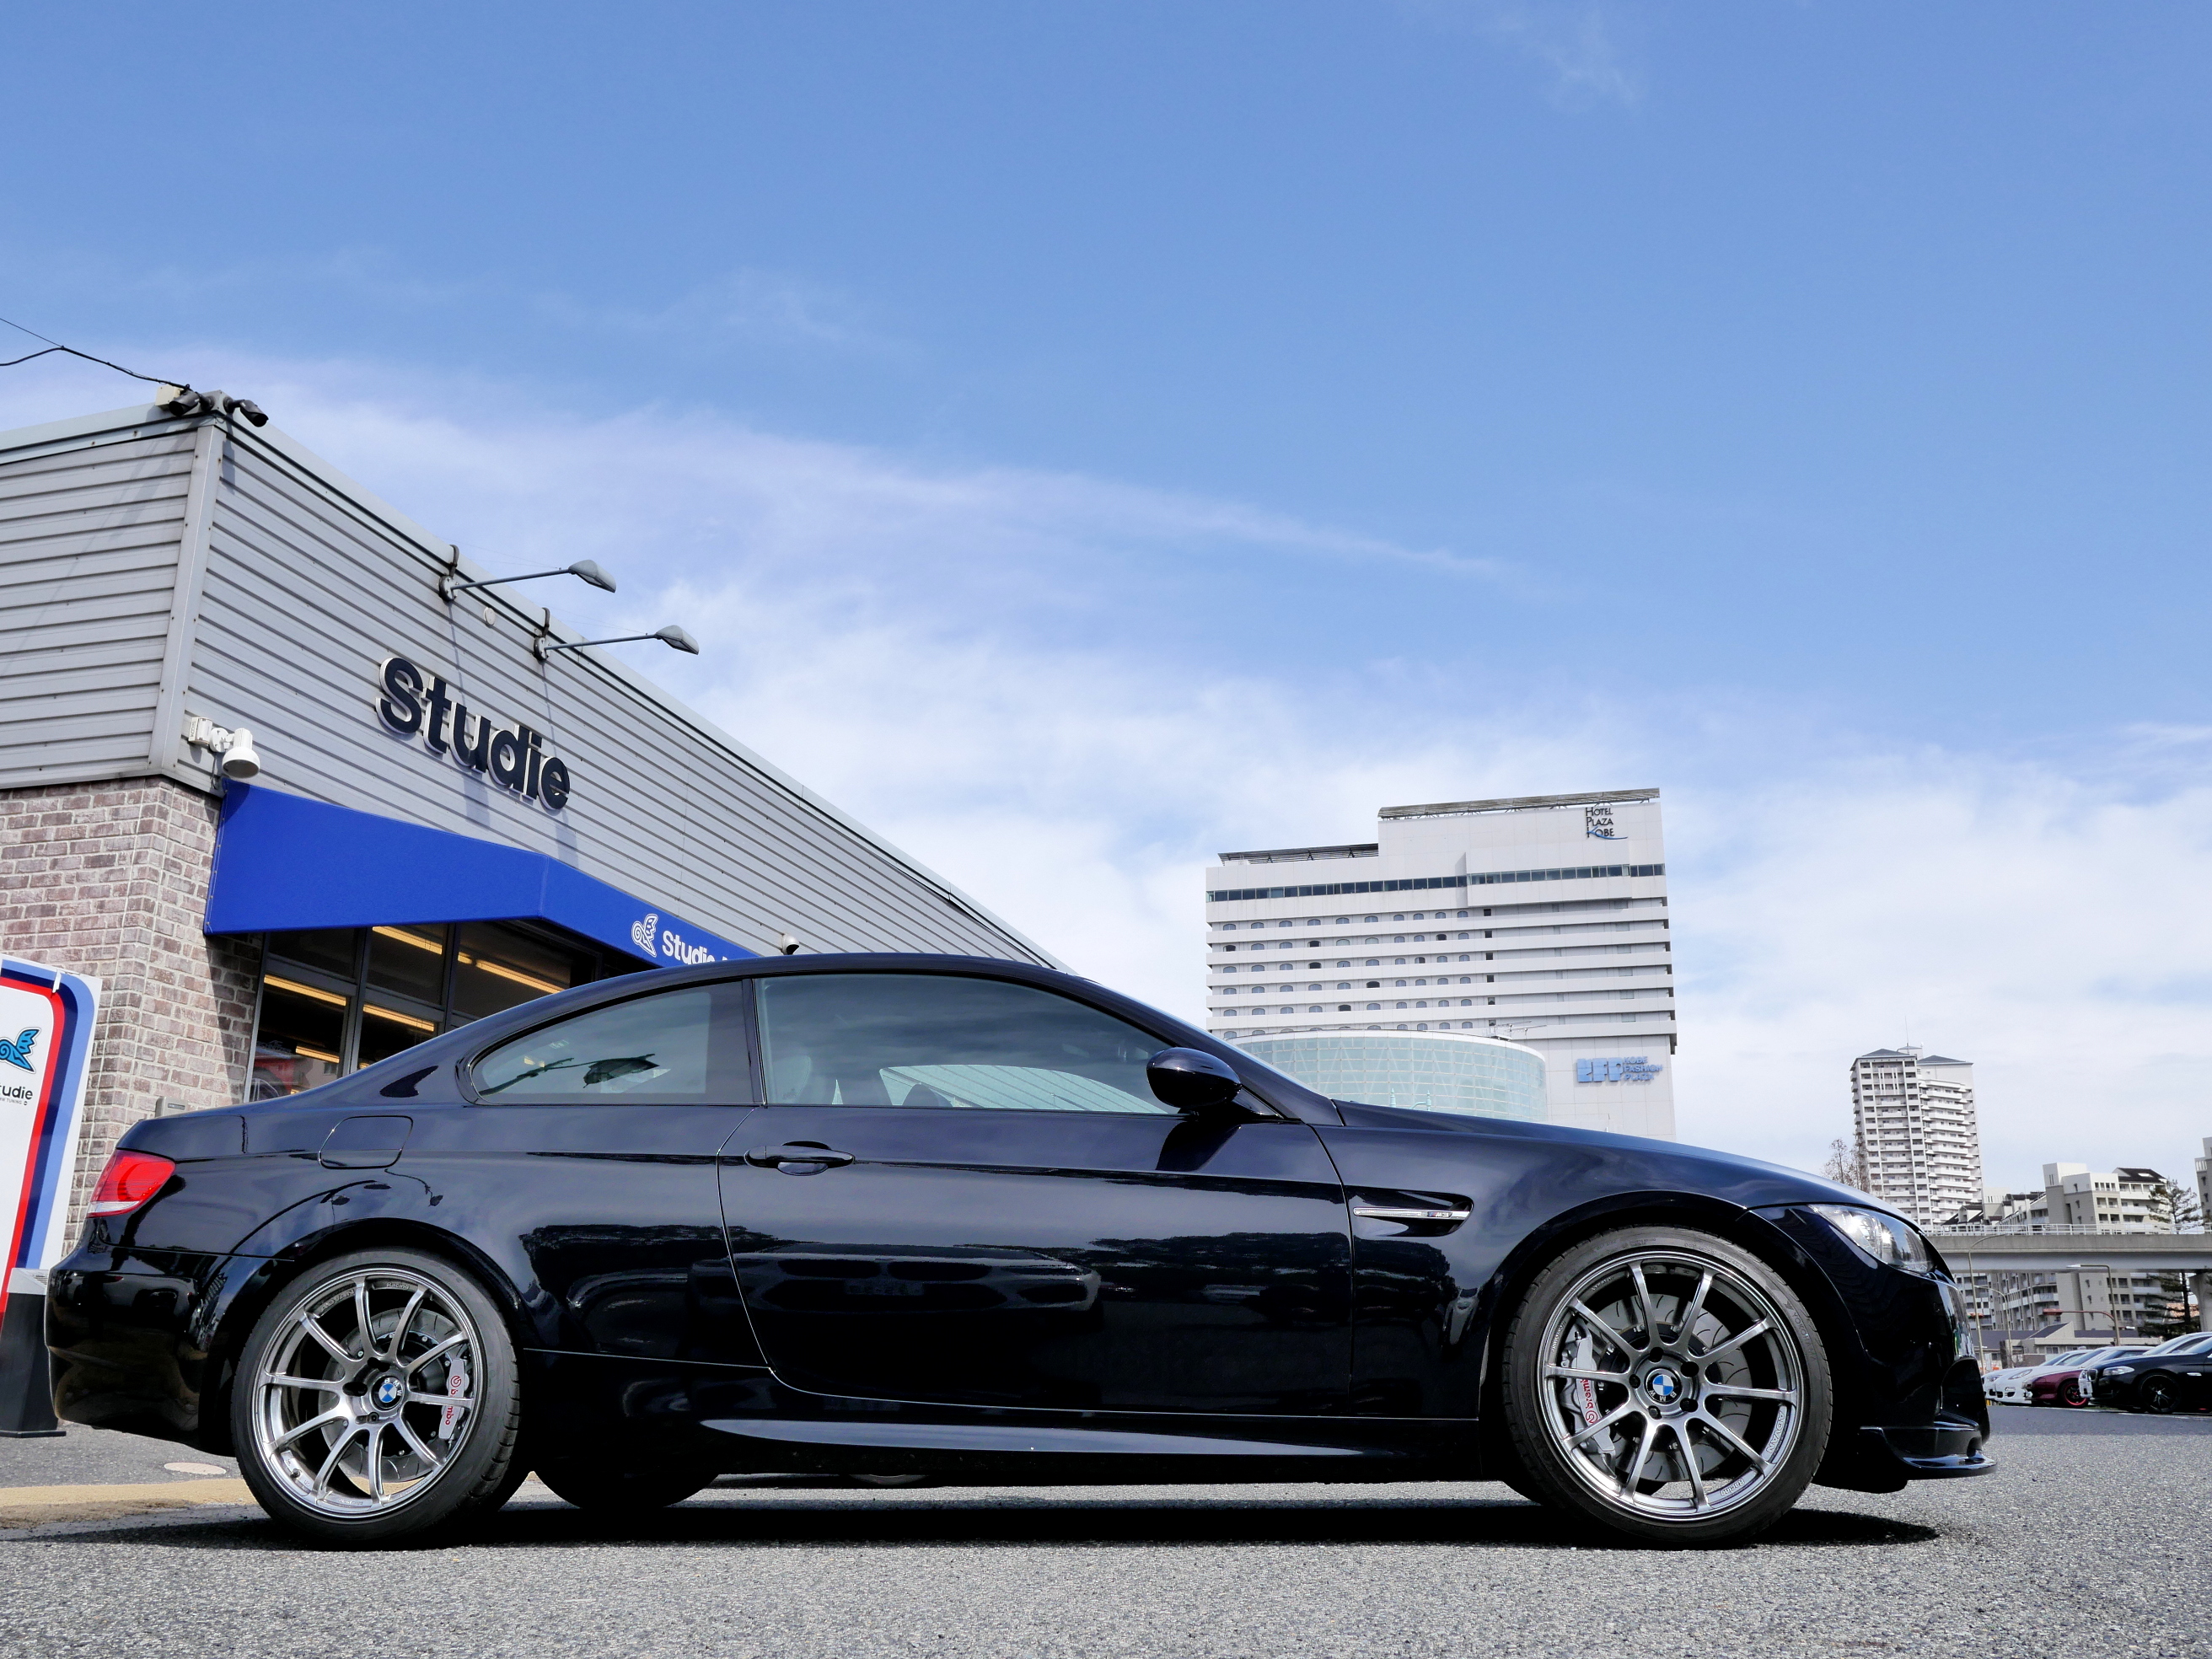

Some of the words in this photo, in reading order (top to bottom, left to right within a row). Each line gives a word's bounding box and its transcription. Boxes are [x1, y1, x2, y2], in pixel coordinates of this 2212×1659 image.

[376, 658, 570, 810] Studie
[1585, 807, 1613, 816] HOTEL
[1586, 816, 1613, 826] PLAZA
[1586, 826, 1613, 840] KOBE
[1624, 1065, 1663, 1073] FASHION
[0, 1085, 33, 1099] udie
[321, 1289, 354, 1312] ADVAN
[384, 1377, 402, 1396] BMW
[1581, 1379, 1594, 1409] bremb
[1649, 1389, 1677, 1402] BMW
[445, 1388, 459, 1425] bmbo
[1766, 1410, 1785, 1453] ADVAN
[1721, 1479, 1745, 1496] Racing
